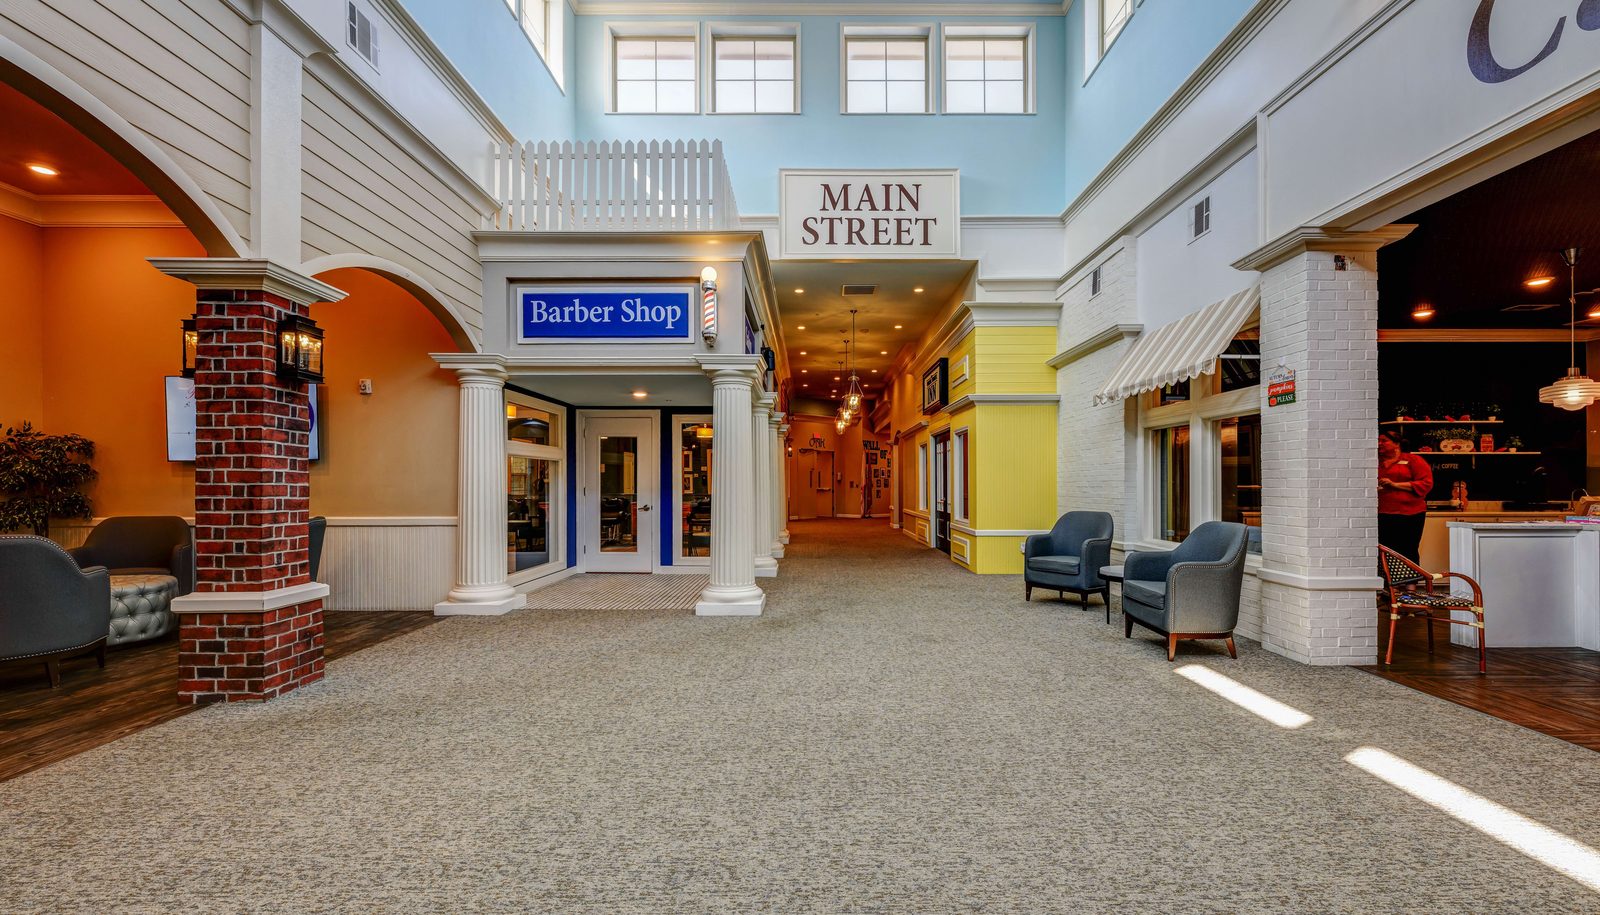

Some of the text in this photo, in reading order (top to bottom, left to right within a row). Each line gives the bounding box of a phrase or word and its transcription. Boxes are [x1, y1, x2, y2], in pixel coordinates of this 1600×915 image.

[819, 183, 922, 212] MAIN
[802, 217, 937, 246] STREET
[530, 298, 681, 330] Barber Shop
